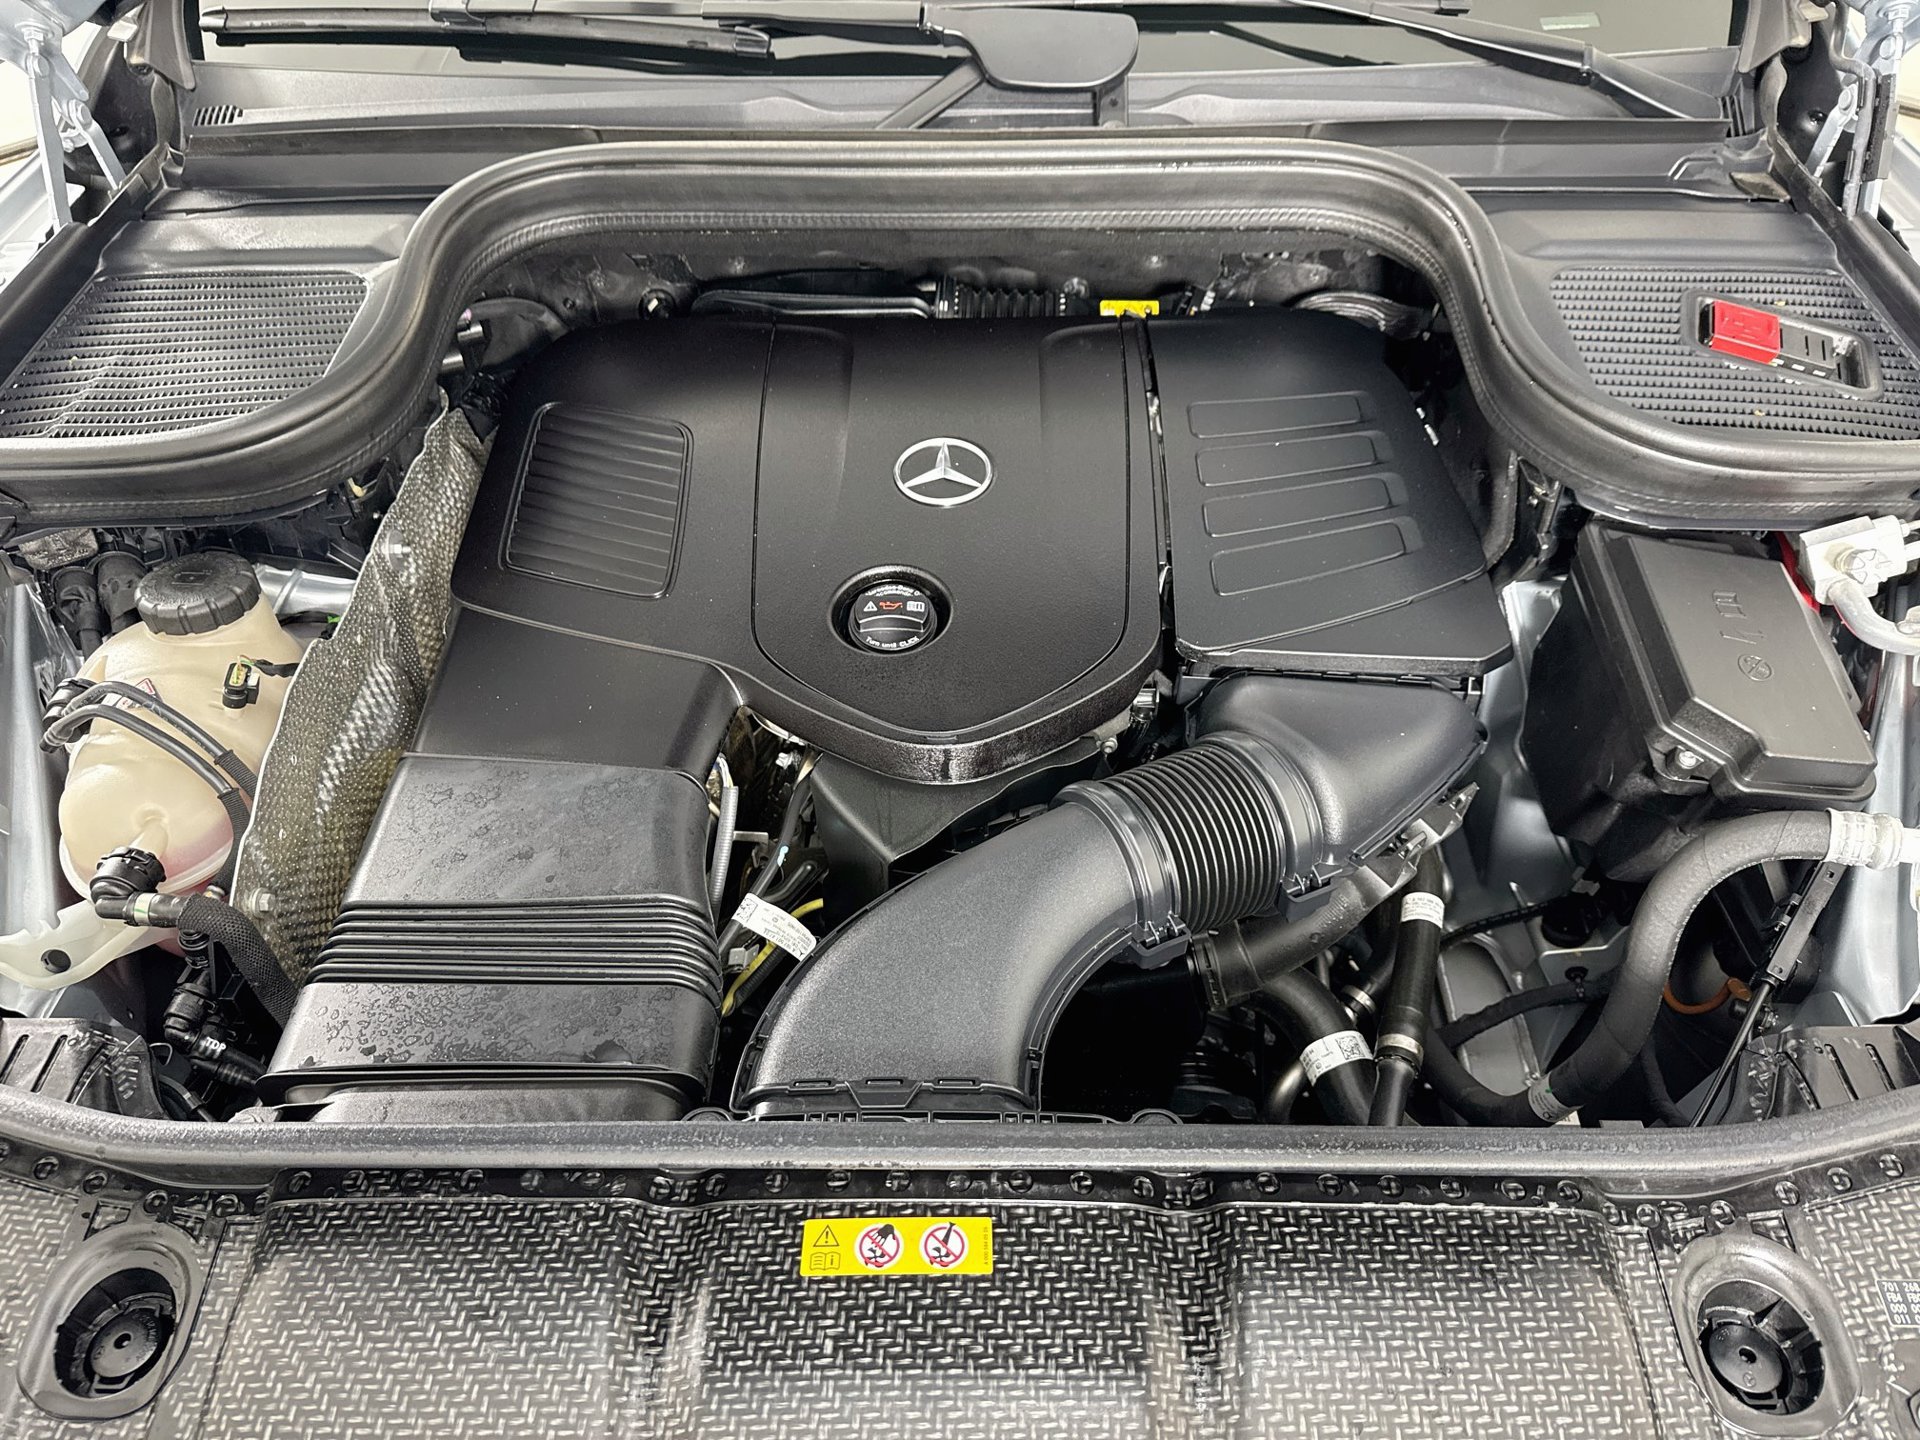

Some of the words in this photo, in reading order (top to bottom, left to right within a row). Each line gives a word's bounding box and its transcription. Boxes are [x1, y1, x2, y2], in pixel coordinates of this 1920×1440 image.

[866, 636, 880, 647] Turn
[899, 635, 920, 647] CLICK
[205, 1036, 227, 1052] TOP
[1881, 1281, 1899, 1292] 701
[1890, 1303, 1908, 1314] 000
[1893, 1313, 1911, 1324] 011
